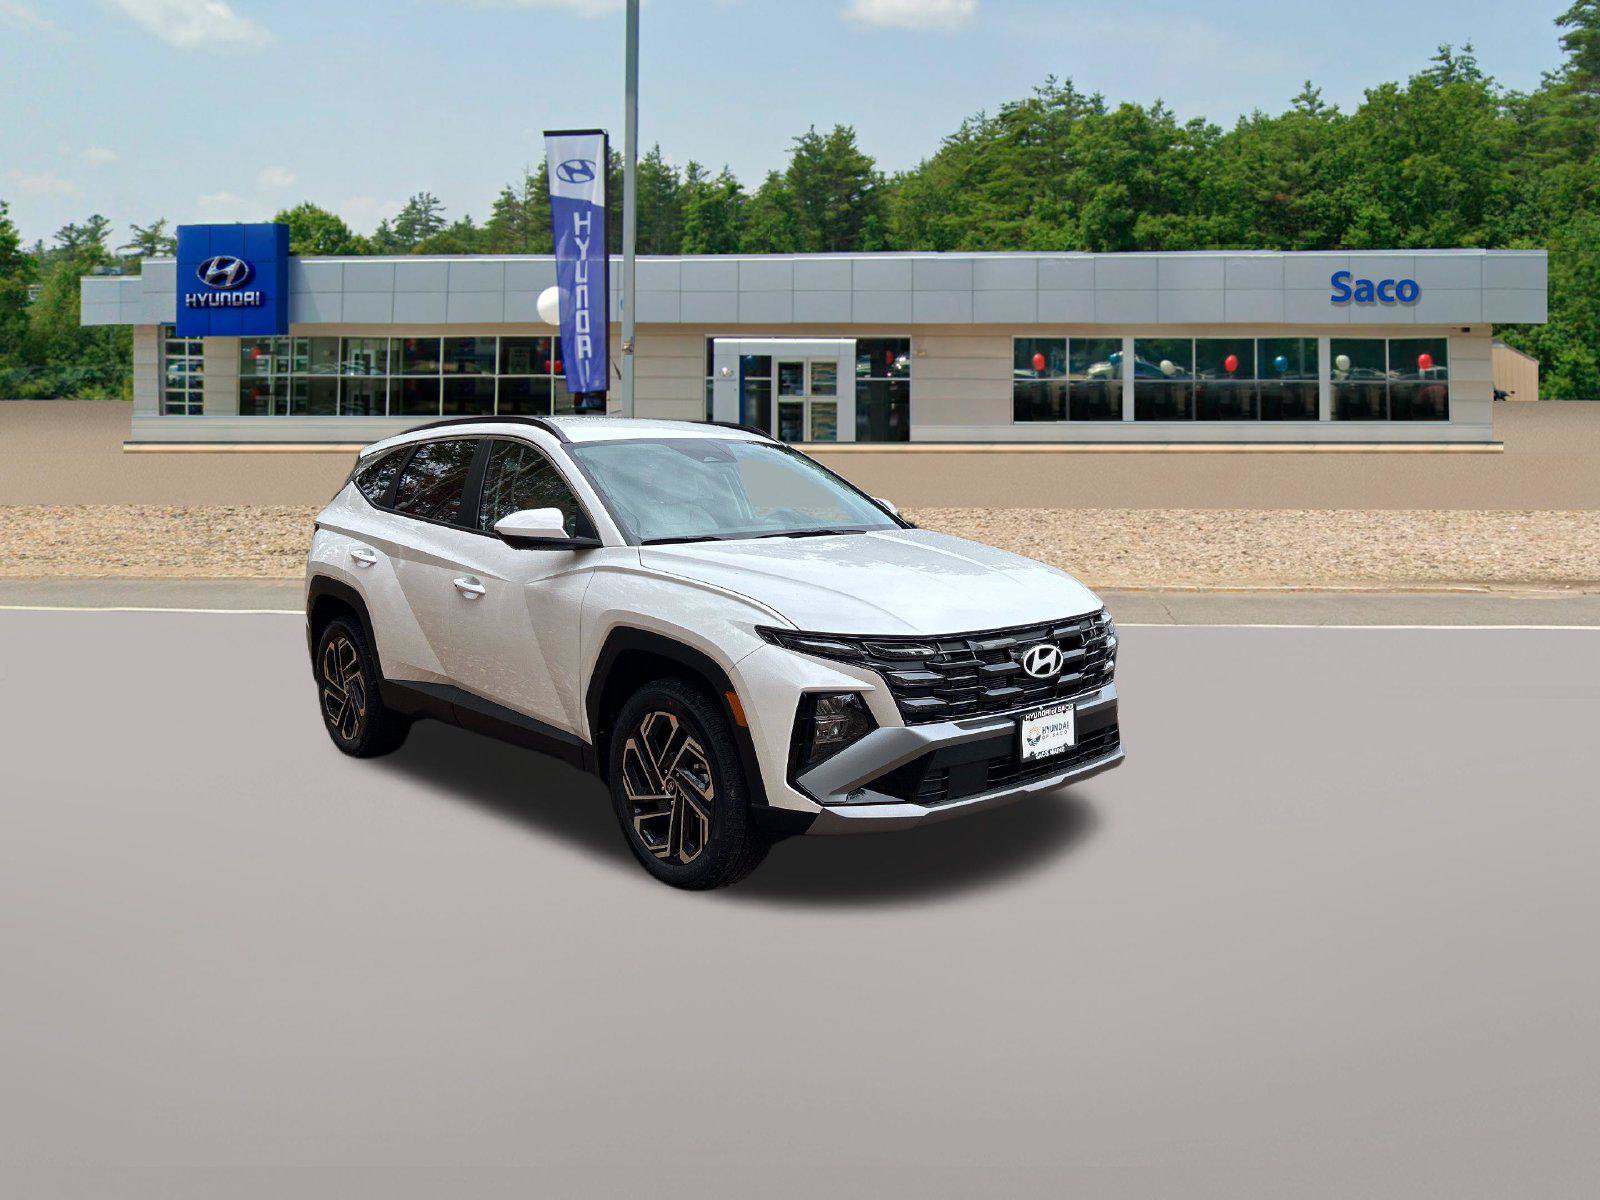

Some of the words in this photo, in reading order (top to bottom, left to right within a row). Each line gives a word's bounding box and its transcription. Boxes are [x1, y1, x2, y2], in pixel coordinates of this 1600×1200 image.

[573, 211, 592, 383] HYUNDAI
[1331, 270, 1419, 302] Saco
[185, 291, 260, 307] HYUNDAI
[1042, 721, 1069, 734] HYUNDAI
